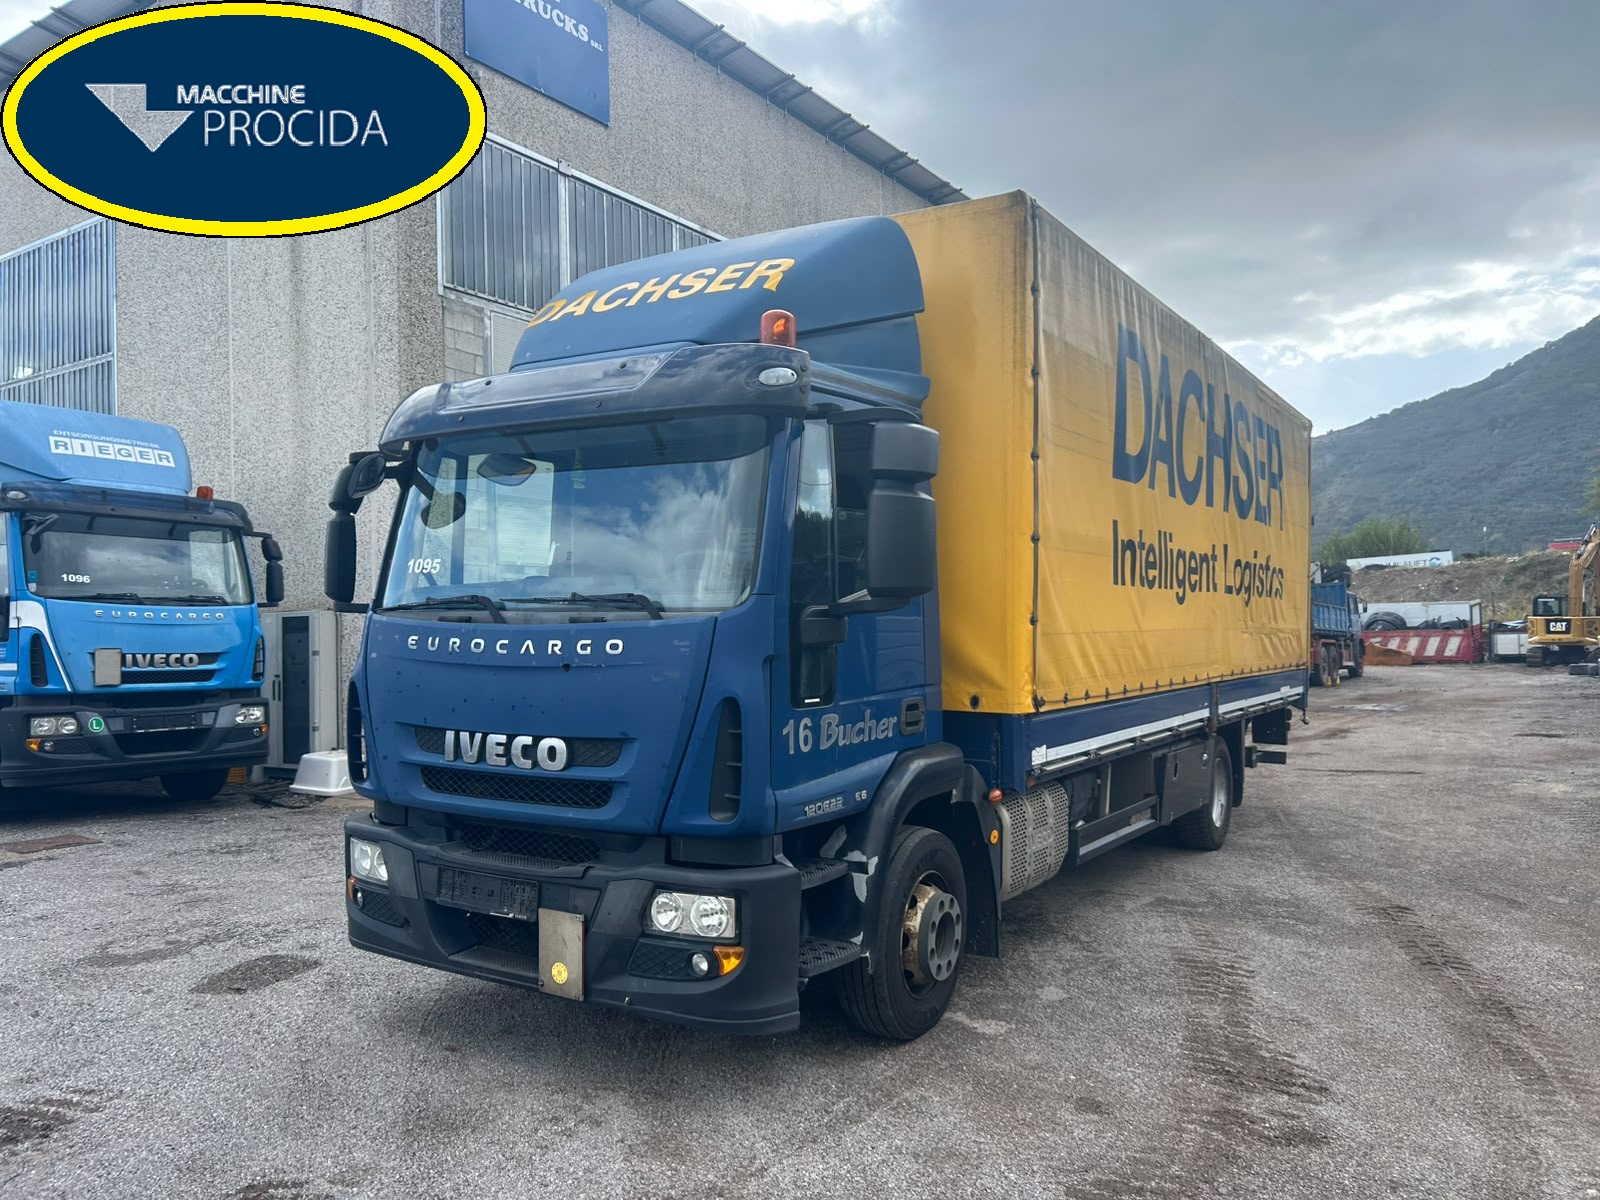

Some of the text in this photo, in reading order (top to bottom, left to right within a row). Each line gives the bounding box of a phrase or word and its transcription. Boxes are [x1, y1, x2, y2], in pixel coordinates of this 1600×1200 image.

[514, 0, 589, 42] RUCKS
[527, 257, 796, 328] DACHSER
[1112, 323, 1284, 531] DACHSER
[53, 439, 173, 464] RIEGER
[407, 558, 441, 574] 1095
[1112, 519, 1284, 608] Intelligent Logistcs
[61, 573, 91, 584] 1096
[94, 609, 225, 621] EUROCARGO
[1549, 621, 1567, 632] CAT
[407, 634, 625, 656] EUROCARGO
[125, 653, 200, 669] IVECO
[782, 709, 898, 755] 16 Bucher
[444, 730, 568, 771] IVECO
